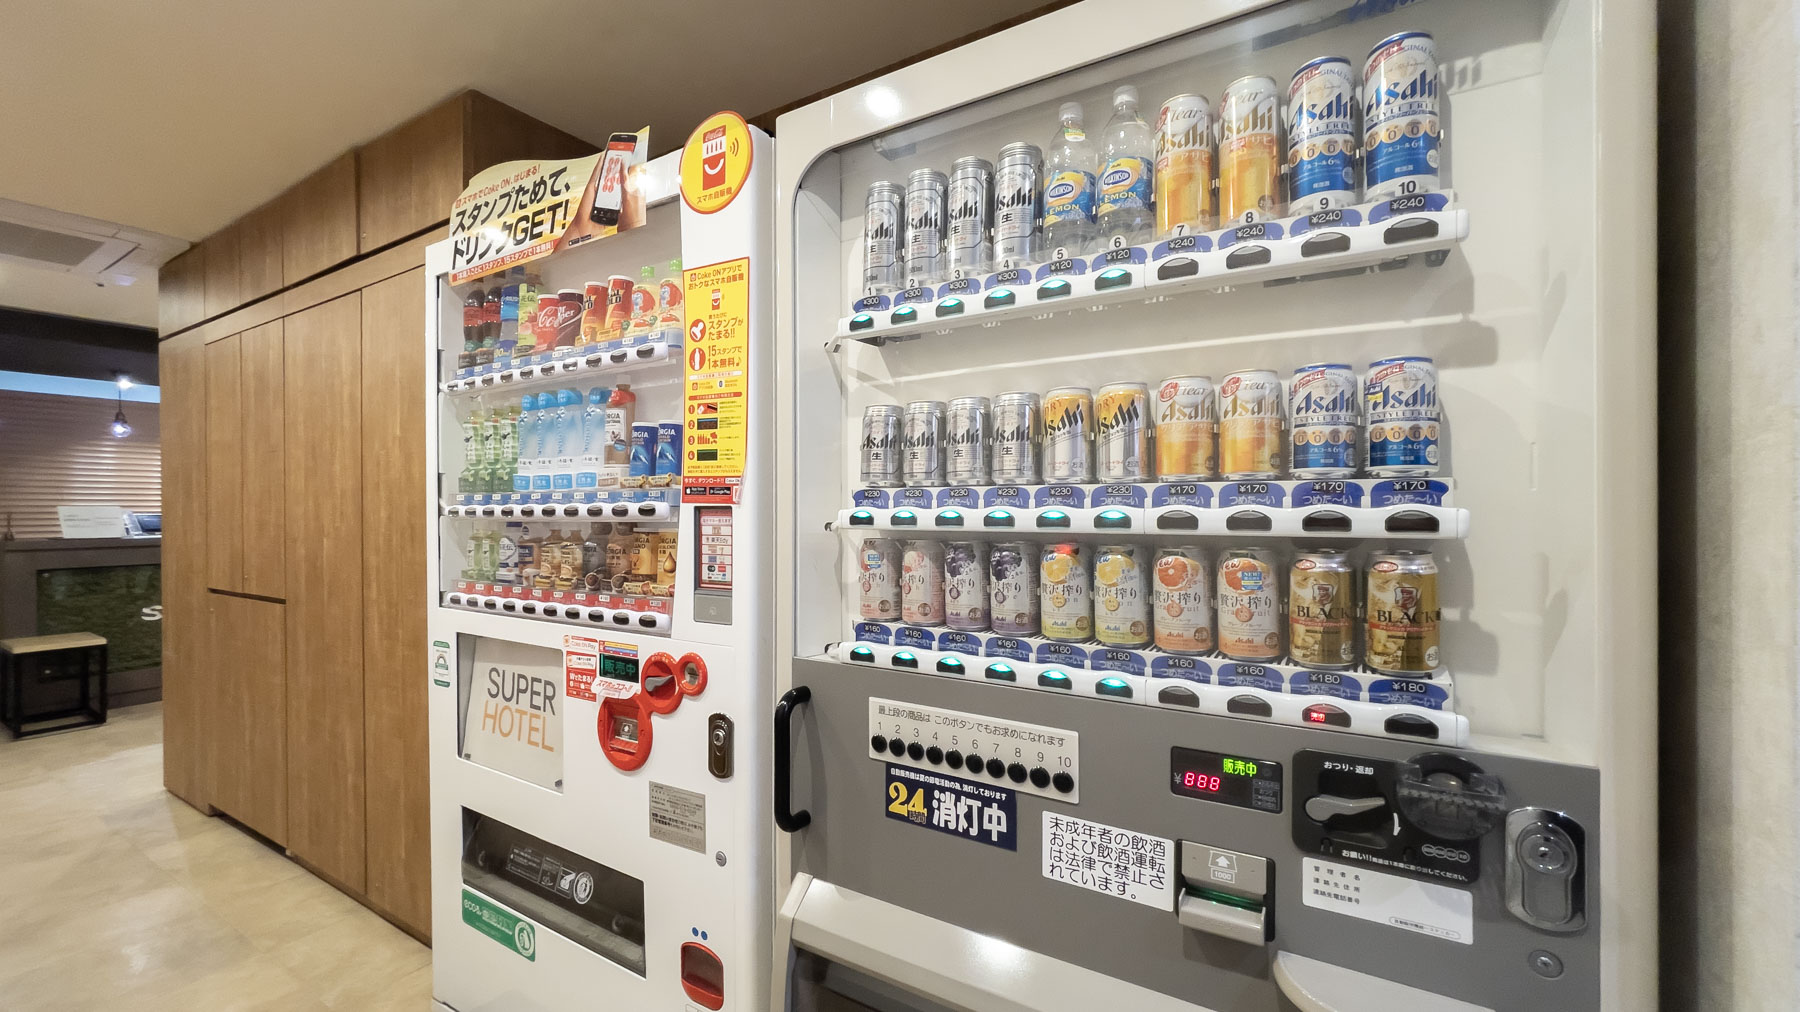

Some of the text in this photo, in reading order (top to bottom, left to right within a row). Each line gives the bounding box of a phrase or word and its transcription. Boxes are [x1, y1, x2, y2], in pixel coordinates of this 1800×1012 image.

[1365, 69, 1438, 117] Asahi
[1168, 108, 1201, 122] lear
[1289, 92, 1354, 135] Asahi
[1156, 121, 1210, 157] Asahi
[1104, 170, 1130, 185] WILKINSON
[1049, 184, 1074, 198] WILKINSON
[1399, 180, 1417, 193] 10
[696, 186, 733, 204] スマホ自販機
[1099, 191, 1136, 205] LEMON
[452, 166, 571, 237] スタンプためて、
[1319, 197, 1329, 210] 9
[1391, 197, 1424, 210] ¥240
[1045, 204, 1080, 217] LEMON
[1001, 212, 1013, 223] 生
[1245, 211, 1253, 223] 8
[1311, 211, 1341, 223] ¥240
[950, 225, 961, 235] 生
[1177, 225, 1185, 236] 7
[1236, 226, 1264, 238] ¥240
[1114, 237, 1121, 248] 6
[1168, 237, 1194, 248] ¥240
[1057, 248, 1064, 259] 5
[1106, 250, 1130, 260] ¥120
[1003, 259, 1009, 269] 4
[1050, 260, 1072, 270] ¥120
[954, 269, 960, 279] 3
[997, 271, 1018, 280] ¥300
[688, 273, 744, 290] おトクなスマホ自販機
[909, 279, 915, 288] 2
[949, 280, 968, 288] ¥300
[867, 287, 873, 295] 1
[905, 289, 921, 297] ¥300
[863, 296, 879, 304] ¥300
[708, 316, 743, 330] スタンプが
[708, 328, 736, 341] たまる!!
[707, 345, 742, 357] 15スタンプで
[1296, 389, 1355, 415] Asahi
[1372, 384, 1437, 410] Asahi
[1161, 398, 1214, 422] Asahi
[1224, 394, 1280, 418] Asahi
[1044, 402, 1084, 438] sahi
[1097, 398, 1139, 436] sahi
[1376, 410, 1406, 419] STYLE
[862, 433, 897, 450] Asahi
[871, 452, 882, 460] 生
[909, 451, 919, 460] 生
[953, 448, 964, 458] 生
[1001, 446, 1013, 455] 生
[1050, 487, 1071, 495] ¥230
[1107, 486, 1130, 494] ¥230
[1169, 485, 1195, 494] ¥170
[1239, 484, 1267, 493] ¥170
[1313, 482, 1344, 491] ¥170
[1393, 481, 1426, 490] ¥170
[905, 489, 922, 497] ¥230
[950, 488, 968, 496] ¥230
[997, 488, 1018, 496] ¥230
[1043, 595, 1078, 603] Leon
[1220, 593, 1272, 610] 贅沢搾り
[1221, 607, 1270, 616] Graruit
[1296, 606, 1349, 618] BLACK
[1377, 610, 1435, 623] BLACK
[1050, 645, 1072, 654] ¥160
[1107, 652, 1130, 661] ¥160
[604, 659, 636, 676] 販売中
[1168, 658, 1194, 668] ¥160
[1236, 666, 1264, 676] ¥160
[1309, 673, 1340, 684] ¥180
[487, 667, 556, 716] SUPER
[1392, 682, 1425, 693] ¥180
[482, 700, 555, 753] HOTEL
[878, 705, 1065, 747] 最上段の商品は このボタンでもお求めになれます
[895, 725, 1071, 768] 2 3 4 5 6 7 8 9 10
[1223, 758, 1257, 777] 販売中
[1324, 761, 1374, 775] おつり・返却
[1174, 772, 1220, 791] ¥ 888
[888, 781, 927, 817] 24
[908, 810, 927, 825] 時間
[932, 789, 1007, 842] 消灯中
[1049, 816, 1166, 858] 未成年者の飲酒
[1049, 832, 1166, 875] および飲酒運転
[1049, 848, 1165, 890] は法律で禁止さ
[1213, 871, 1232, 880] 1000
[1049, 864, 1137, 900] れています。
